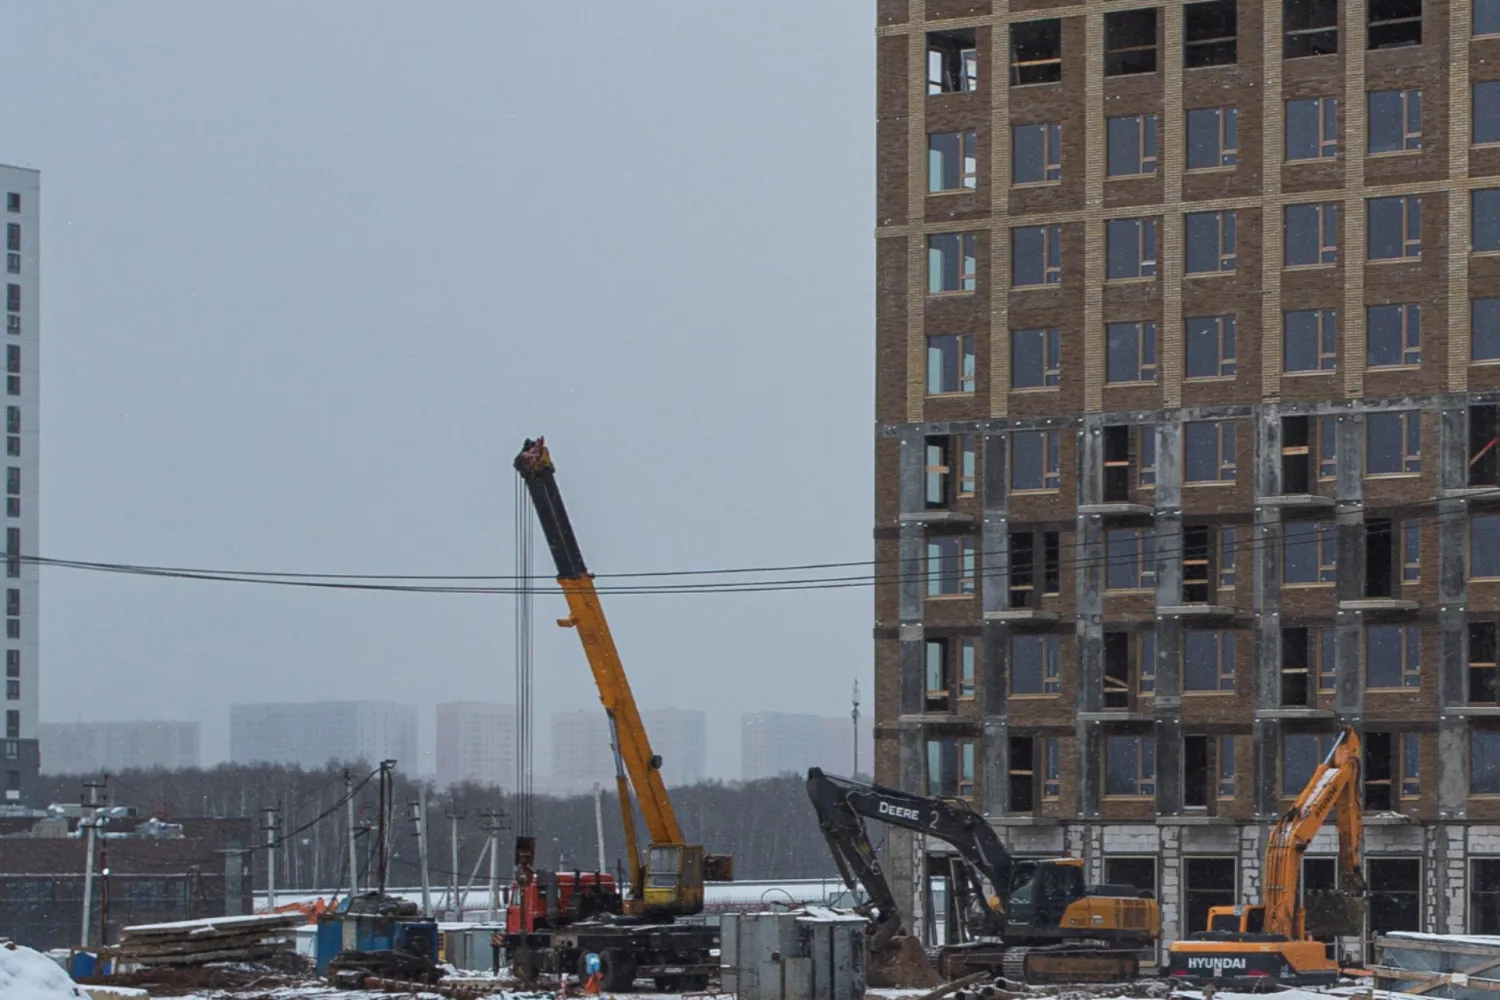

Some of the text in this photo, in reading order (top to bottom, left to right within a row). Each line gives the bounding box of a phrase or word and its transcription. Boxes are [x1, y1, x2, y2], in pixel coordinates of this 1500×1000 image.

[879, 801, 920, 820] DEERE
[929, 810, 940, 829] 2
[1188, 958, 1247, 969] HYUNDAI
